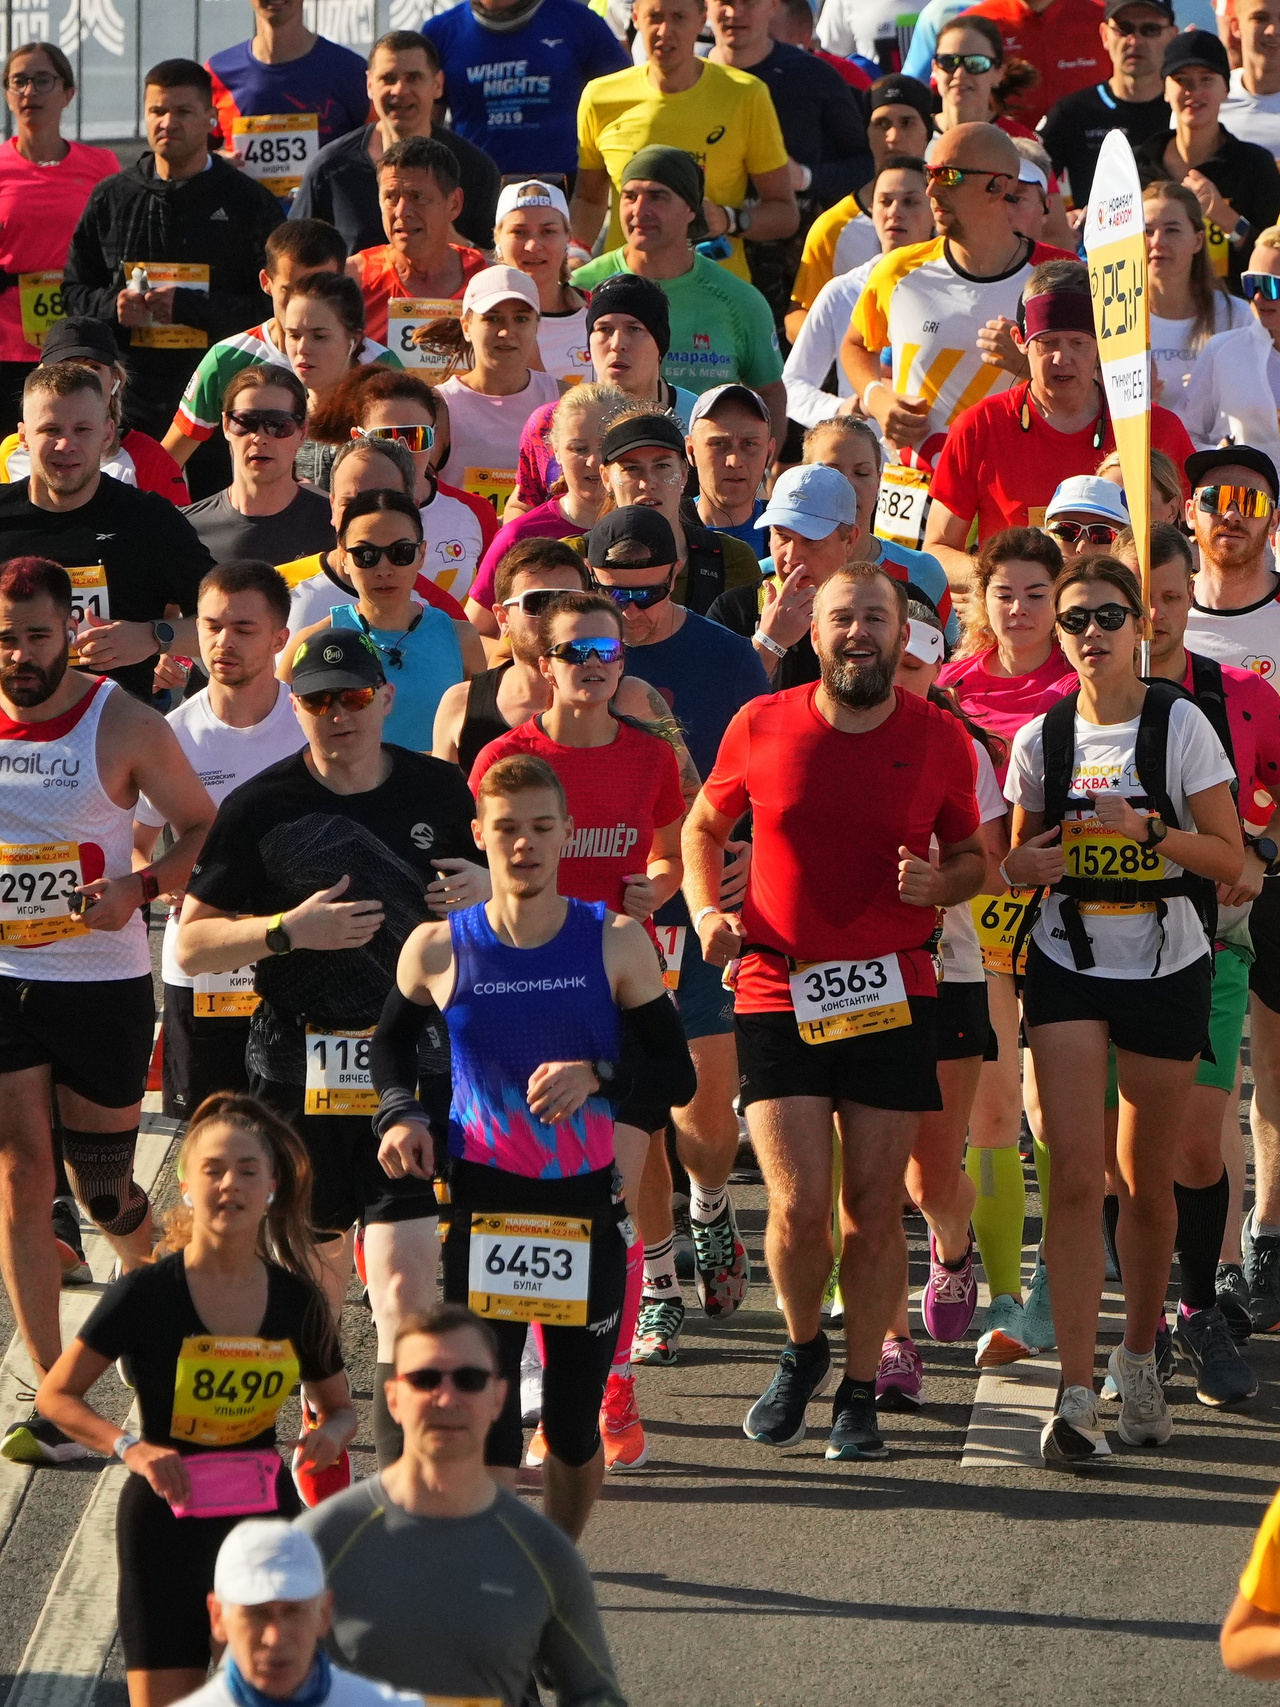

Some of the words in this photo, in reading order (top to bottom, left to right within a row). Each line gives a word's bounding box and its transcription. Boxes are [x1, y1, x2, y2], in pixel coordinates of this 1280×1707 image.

[466, 60, 528, 83] WHITE
[483, 76, 550, 97] NIGHTS
[487, 111, 523, 125] 2019
[244, 138, 307, 164] 4853
[922, 321, 940, 334] GRi
[43, 778, 79, 790] group
[1069, 845, 1160, 876] 15288
[0, 869, 79, 904] 2923
[16, 905, 46, 916] ИГОРЬ
[473, 976, 587, 995] СОВКОМБАНК
[804, 961, 888, 1003] 3563
[821, 993, 880, 1012] КОНСТАНТИН
[101, 1151, 130, 1163] ROUTE
[505, 1225, 543, 1234] МОСКВА
[485, 1243, 573, 1281] 6453
[513, 1281, 542, 1292] БУЛАТ
[192, 1368, 283, 1404] 8490
